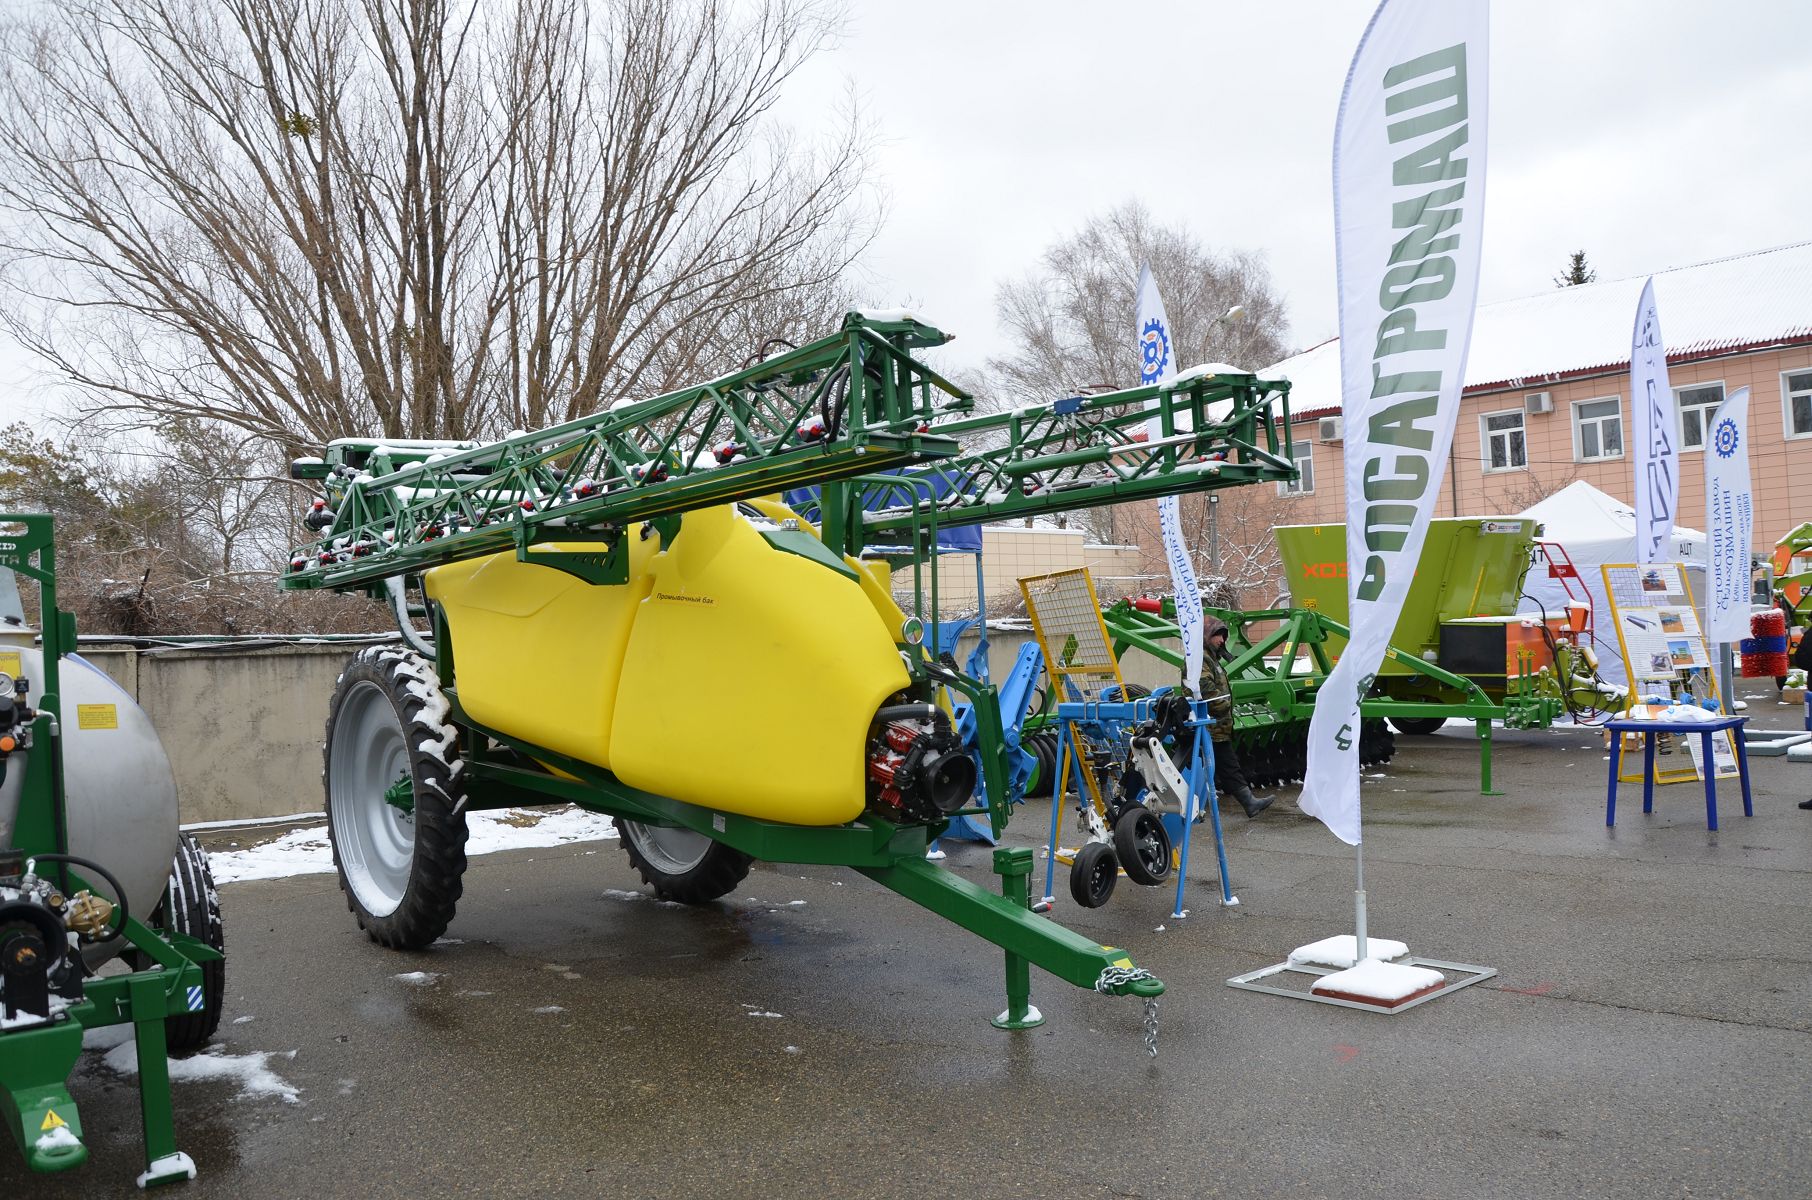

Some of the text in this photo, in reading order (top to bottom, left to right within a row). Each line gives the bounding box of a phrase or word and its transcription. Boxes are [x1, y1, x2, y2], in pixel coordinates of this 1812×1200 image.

[1680, 542, 1692, 557] АЦТ
[1712, 477, 1724, 622] СТОВСКИЙ ЗАВОД
[656, 592, 714, 604] Промывочный бак
